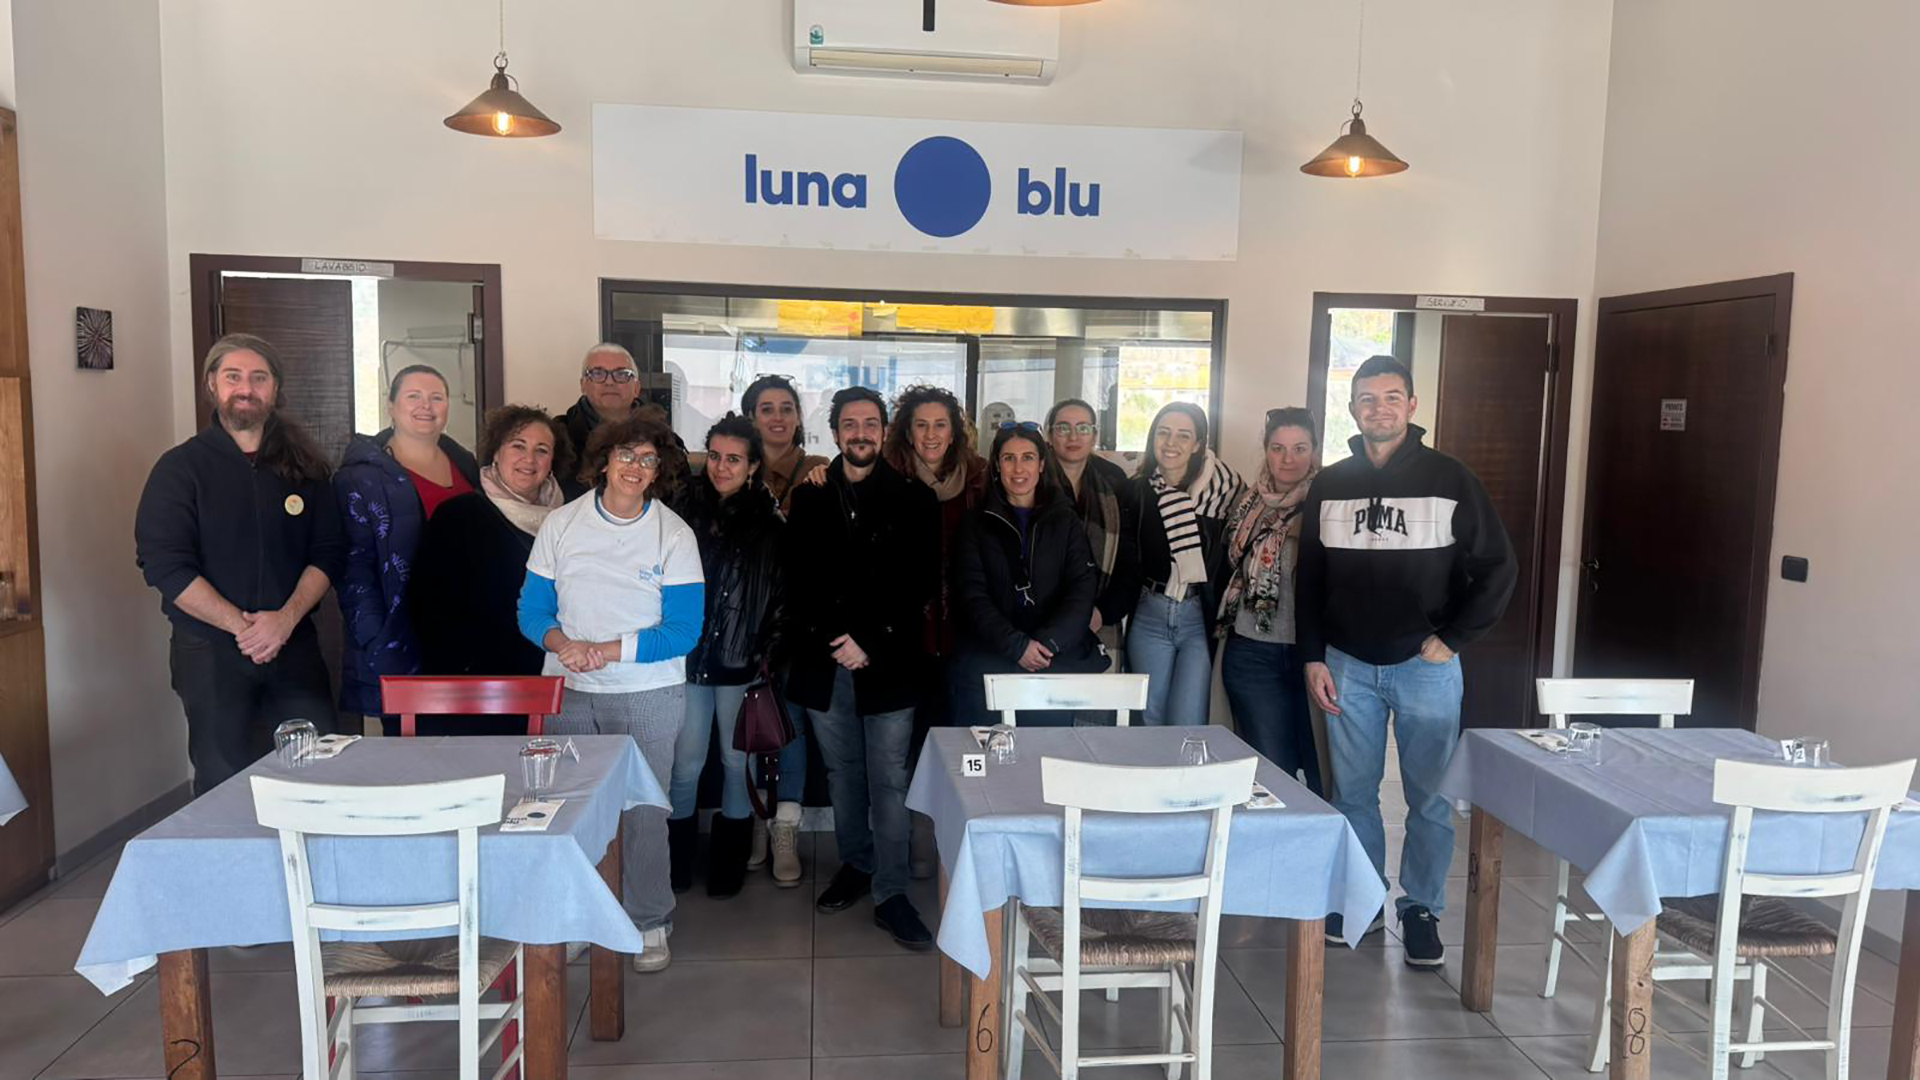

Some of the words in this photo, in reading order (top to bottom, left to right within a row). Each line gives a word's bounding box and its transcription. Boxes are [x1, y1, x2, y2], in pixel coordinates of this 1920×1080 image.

[745, 153, 867, 208] luna
[1017, 167, 1100, 216] blu
[1353, 505, 1409, 536] PUMA
[967, 759, 982, 772] 15
[976, 1003, 993, 1053] 6
